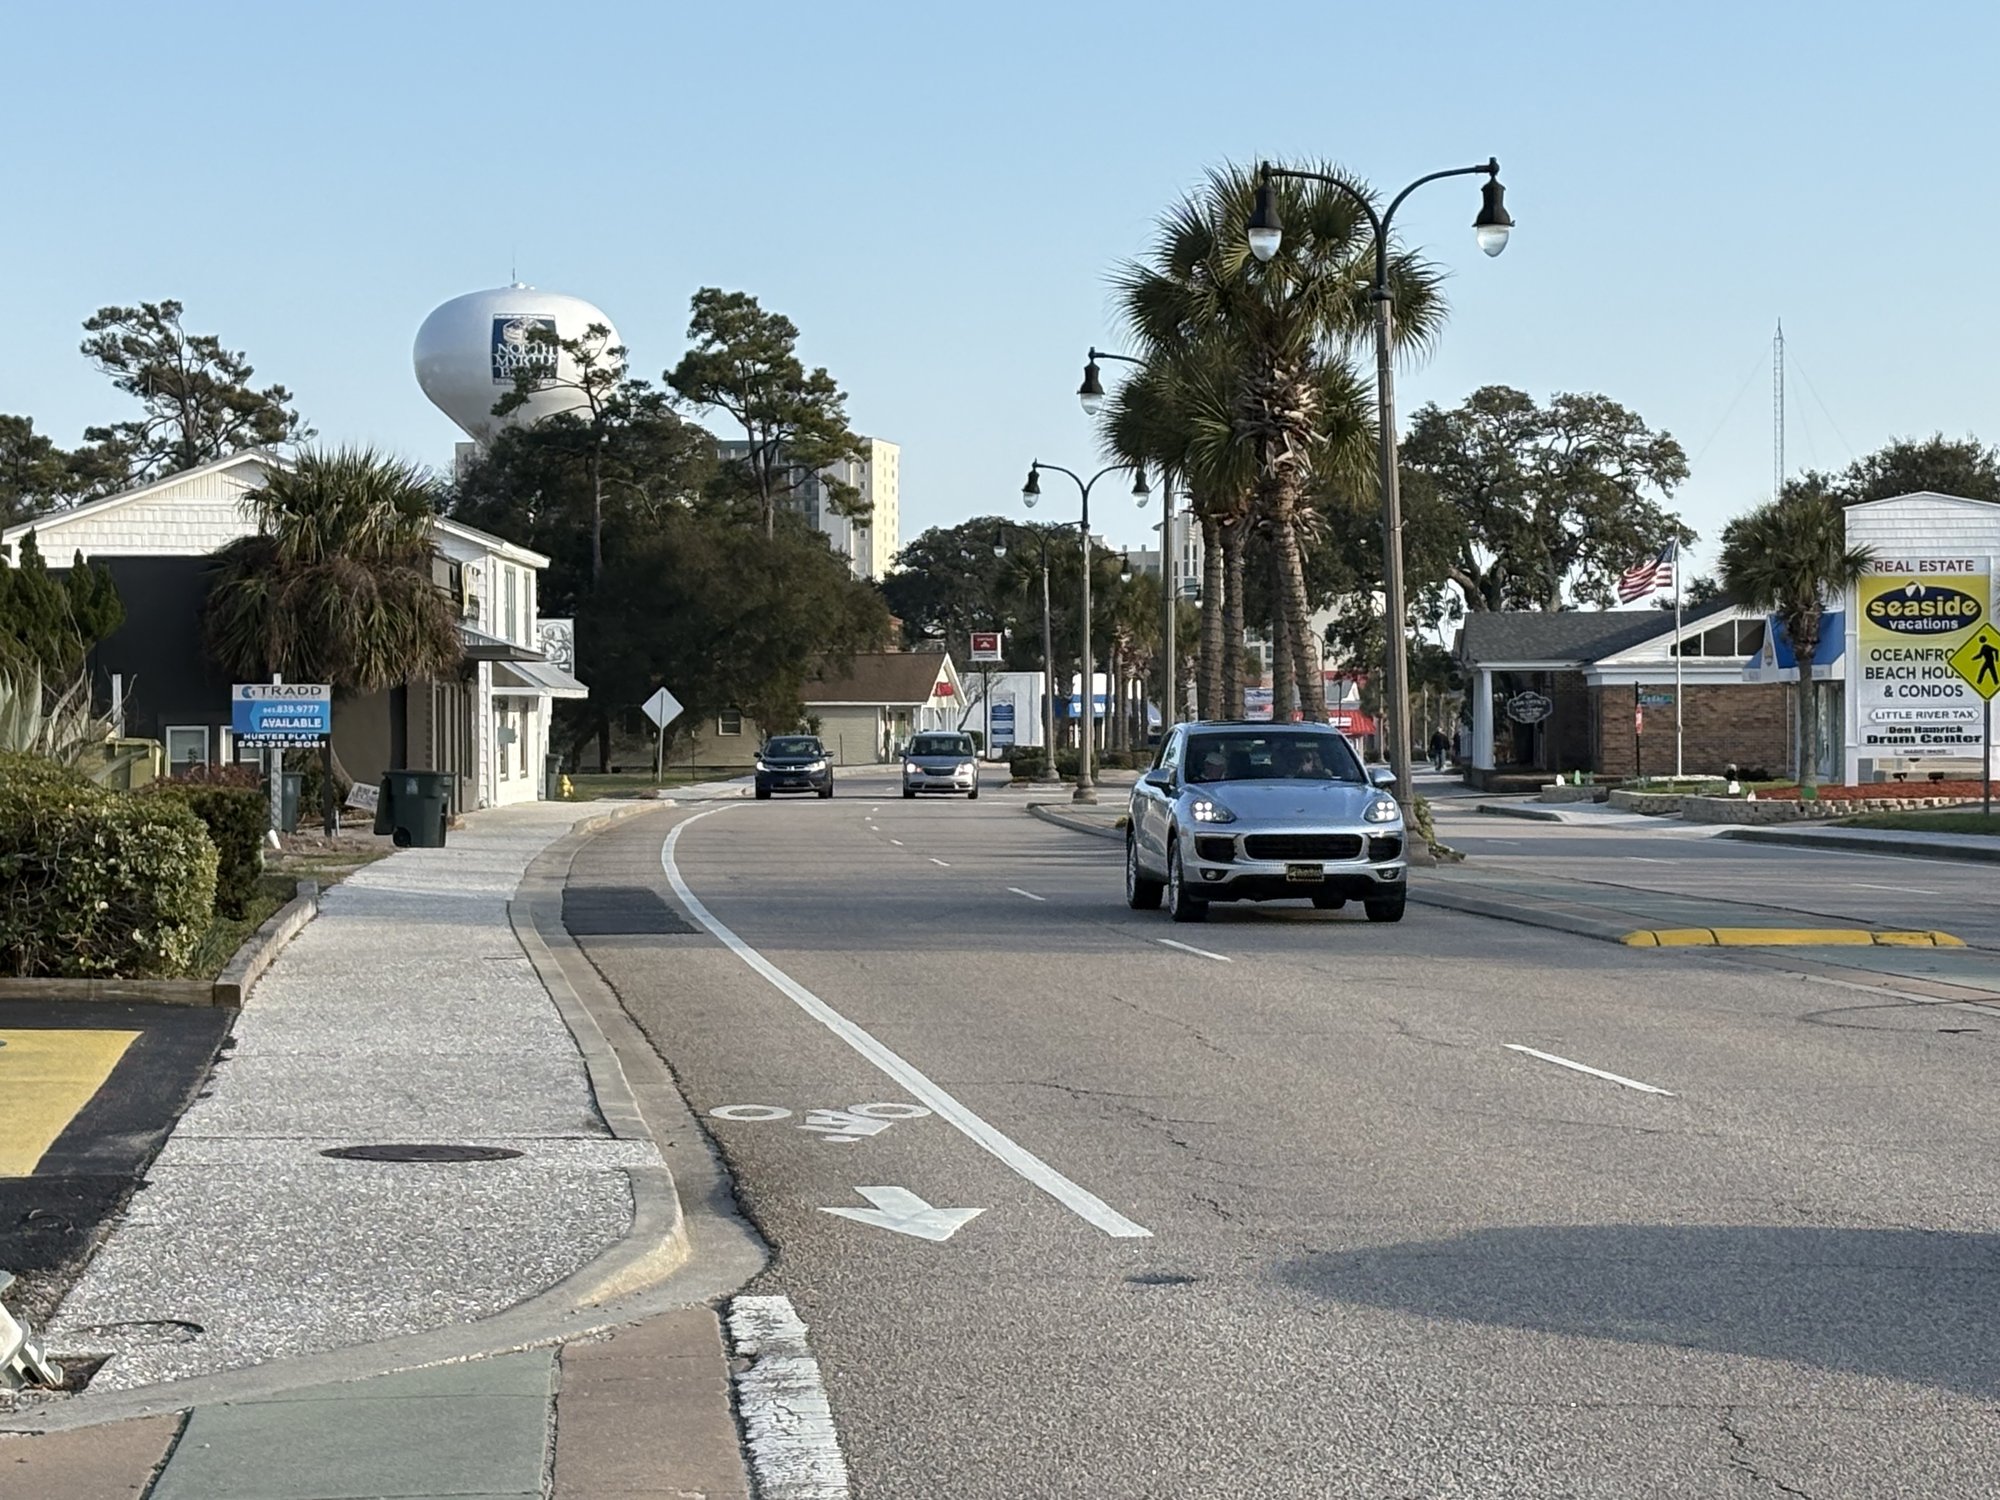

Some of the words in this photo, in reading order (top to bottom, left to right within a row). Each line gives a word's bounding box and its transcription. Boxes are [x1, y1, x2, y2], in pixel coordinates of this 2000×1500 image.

[1874, 560, 1914, 572] REAL
[1919, 560, 1975, 572] ESTATE
[1870, 596, 1978, 617] seaside
[1889, 617, 1959, 630] vacations
[1870, 648, 1955, 661] OCEANFRO
[1865, 666, 1916, 680] BEACH
[1922, 666, 1961, 680] HOU
[257, 686, 322, 696] TRADD
[1884, 685, 1894, 697] &
[1898, 685, 1964, 698] CONDOS
[1875, 711, 1913, 719] LITTLE
[1916, 711, 1949, 719] RIVER
[1952, 711, 1974, 719] TAX
[261, 718, 322, 728] AVAILABLE
[243, 733, 285, 741] HUNTER
[1866, 735, 1916, 744] Drum
[1920, 734, 1982, 744] Center
